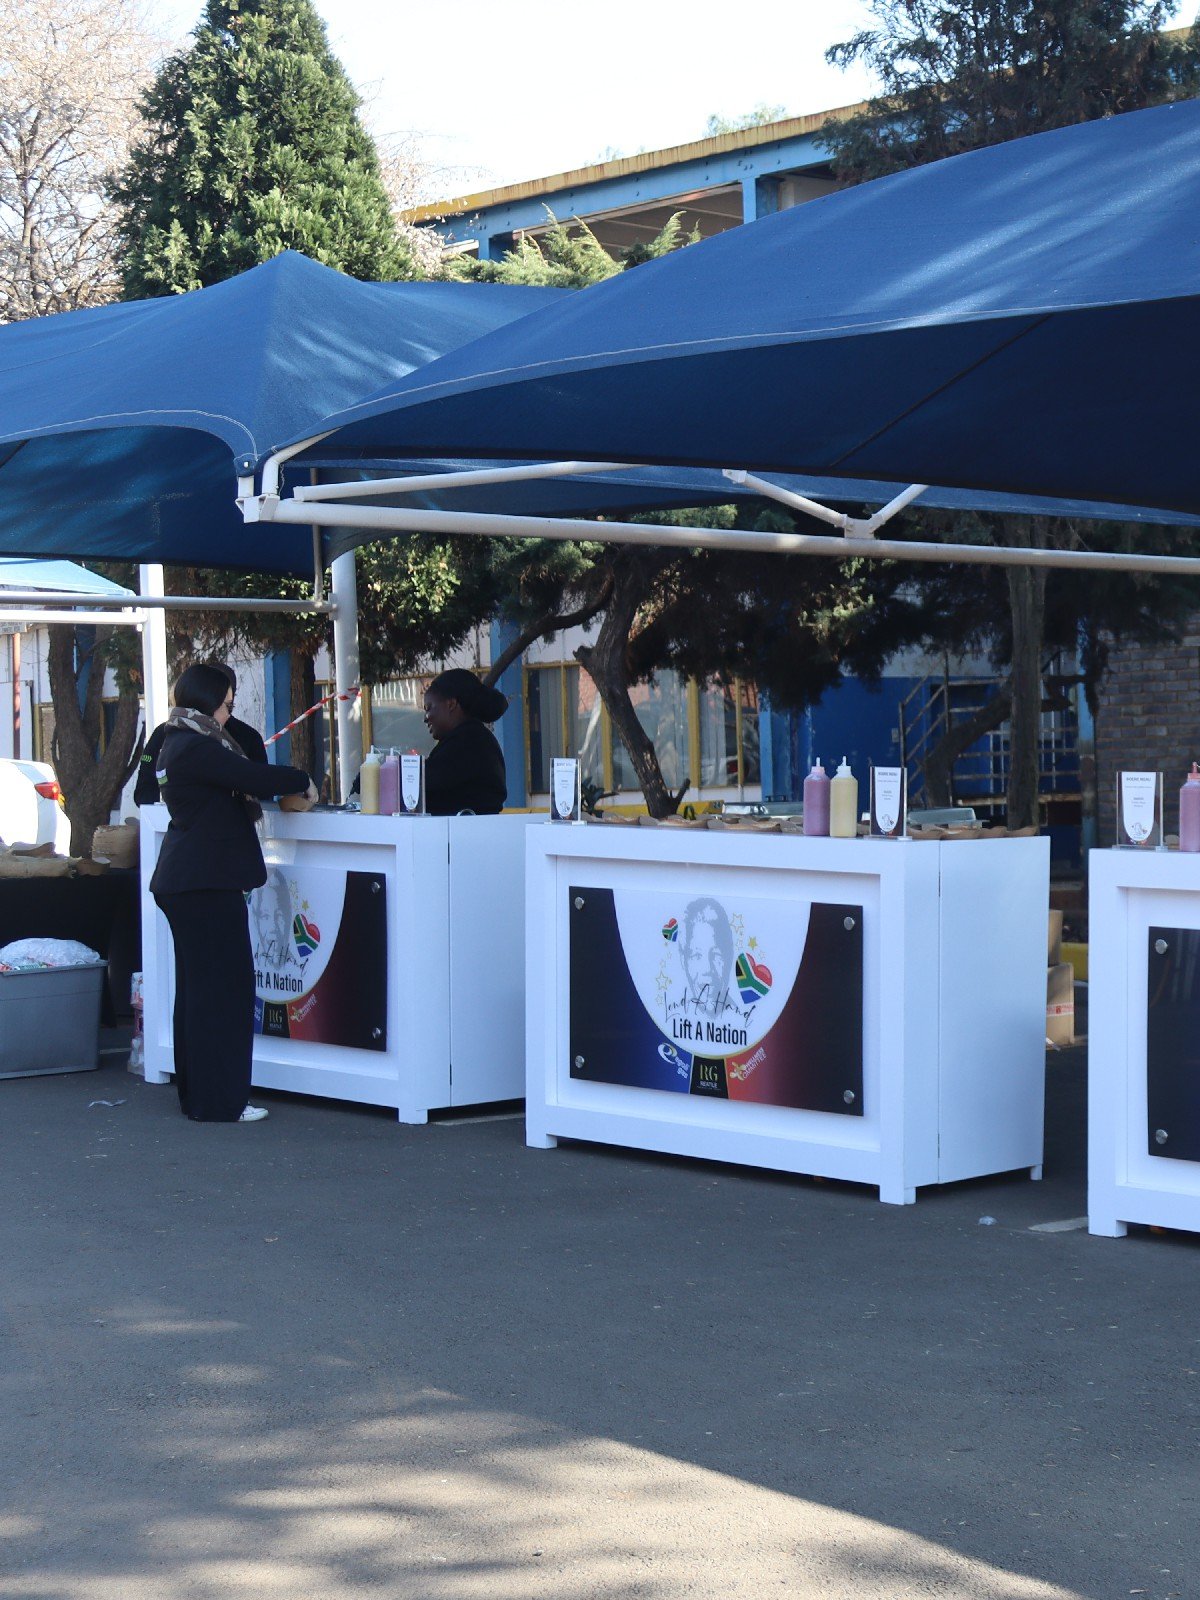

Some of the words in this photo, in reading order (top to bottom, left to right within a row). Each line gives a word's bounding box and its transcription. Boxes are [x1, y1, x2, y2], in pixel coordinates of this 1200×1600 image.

[265, 971, 271, 989] A
[273, 972, 303, 993] Nation
[664, 987, 688, 1023] Lend
[713, 987, 756, 1028] Hand
[673, 1018, 692, 1040] Lift
[695, 1021, 703, 1041] A
[707, 1022, 747, 1046] Nation
[700, 1064, 718, 1081] RG
